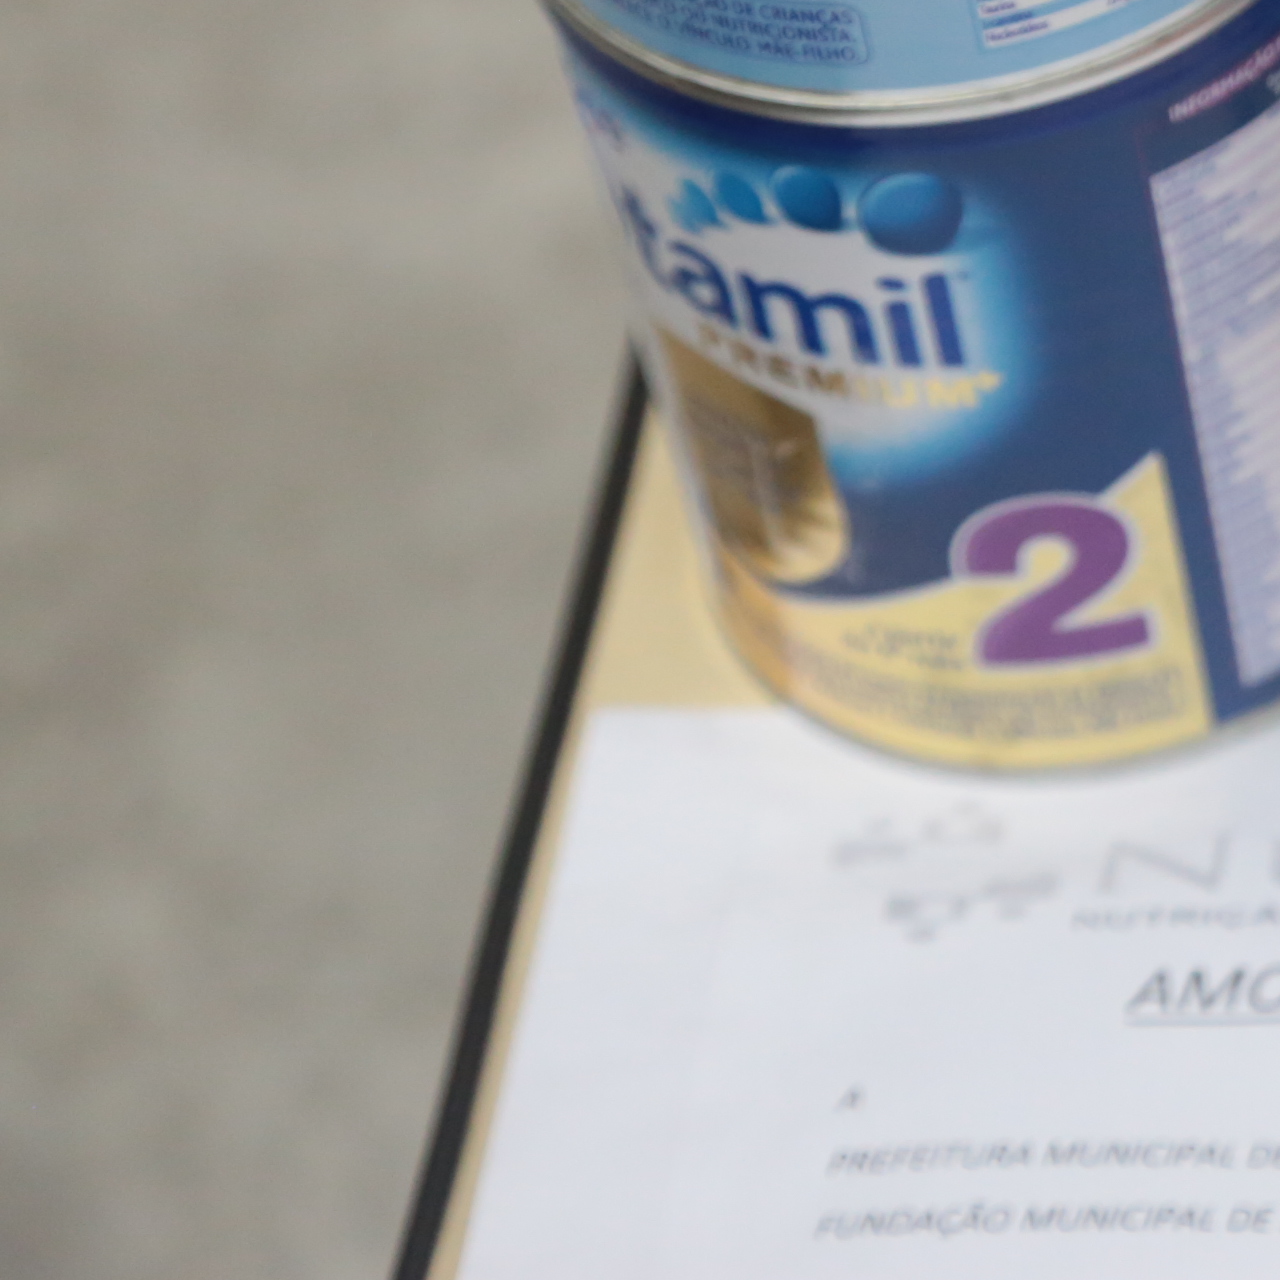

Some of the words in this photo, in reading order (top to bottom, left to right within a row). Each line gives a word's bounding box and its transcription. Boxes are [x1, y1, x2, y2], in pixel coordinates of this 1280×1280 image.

[622, 185, 968, 369] tamil
[962, 500, 1151, 666] 2
[826, 1138, 1033, 1180] PREFEITURA
[1040, 1137, 1237, 1171] MUNICIPAL
[813, 1194, 1010, 1242] FUNDAÇÃO
[1018, 1201, 1216, 1236] MUNICIPAL
[1223, 1203, 1274, 1235] DE
